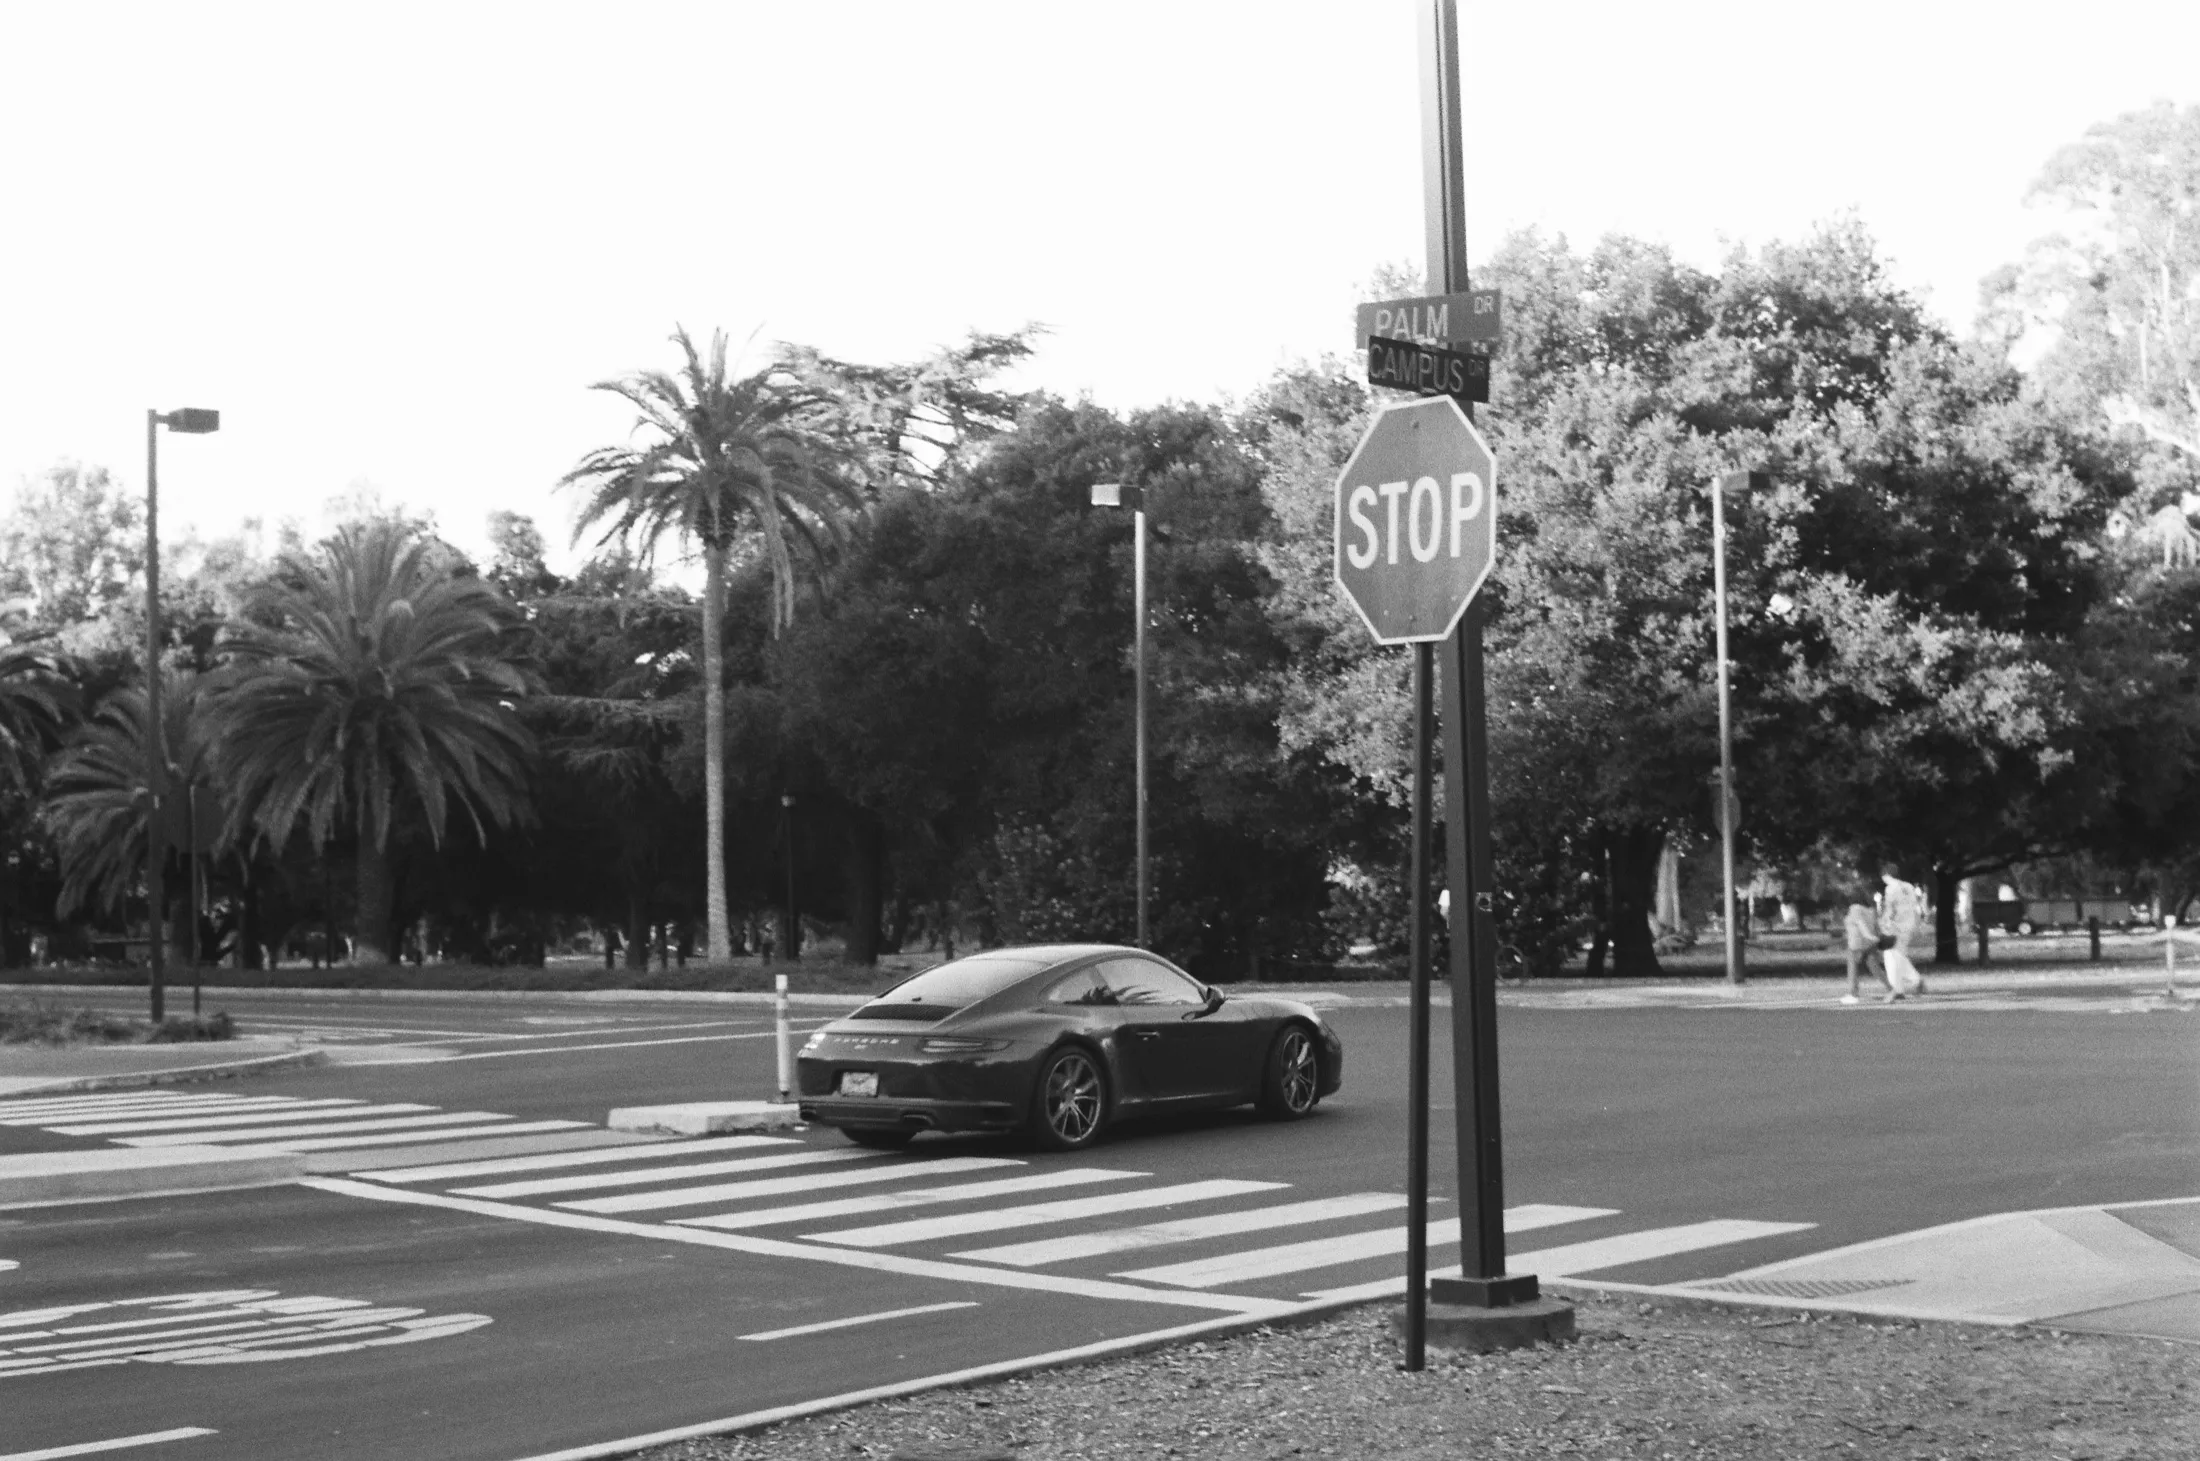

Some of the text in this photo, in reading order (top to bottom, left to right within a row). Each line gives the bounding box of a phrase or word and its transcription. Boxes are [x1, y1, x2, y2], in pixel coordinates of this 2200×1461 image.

[1374, 296, 1494, 341] PALM DR
[1369, 343, 1486, 393] CAMPUS DR
[1347, 472, 1483, 569] STOP
